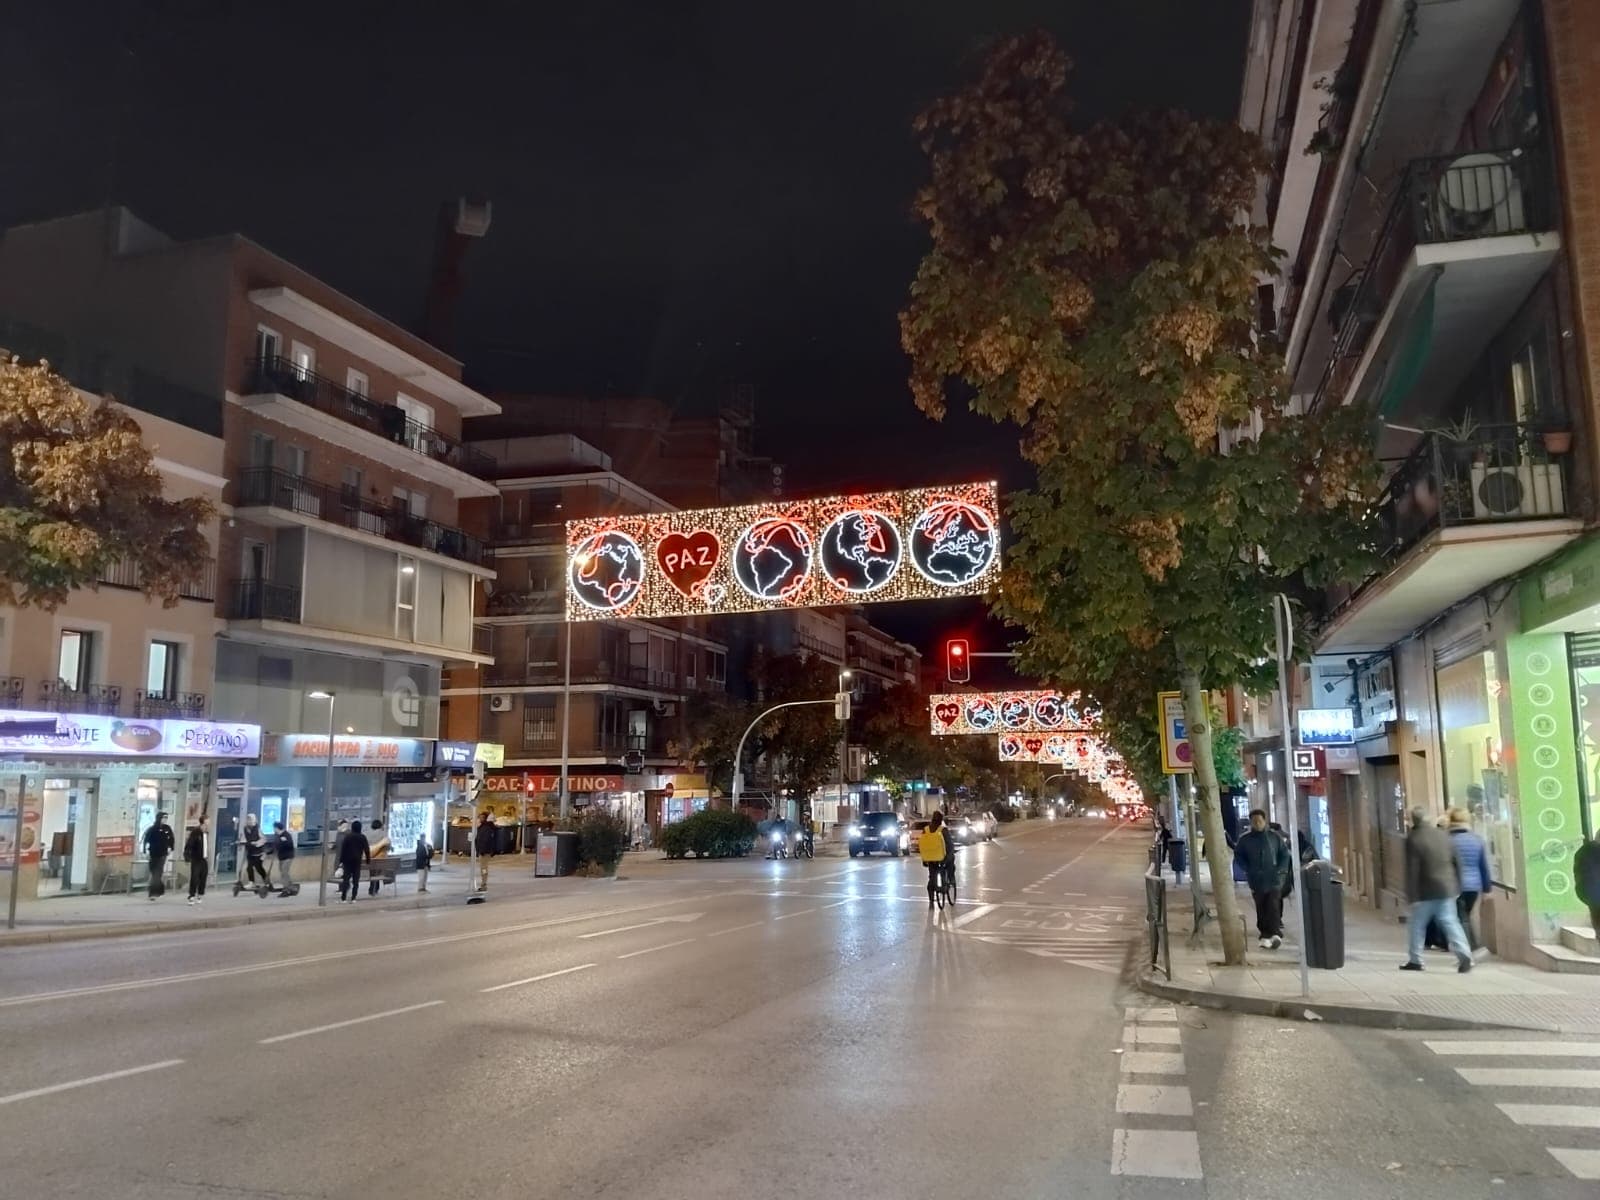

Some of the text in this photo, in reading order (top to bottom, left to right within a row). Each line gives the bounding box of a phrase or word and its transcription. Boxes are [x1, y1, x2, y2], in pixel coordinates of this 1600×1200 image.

[664, 546, 713, 573] PAZ
[937, 708, 958, 719] PAZ
[184, 728, 241, 748] PERUANO
[541, 777, 608, 791] LATINO
